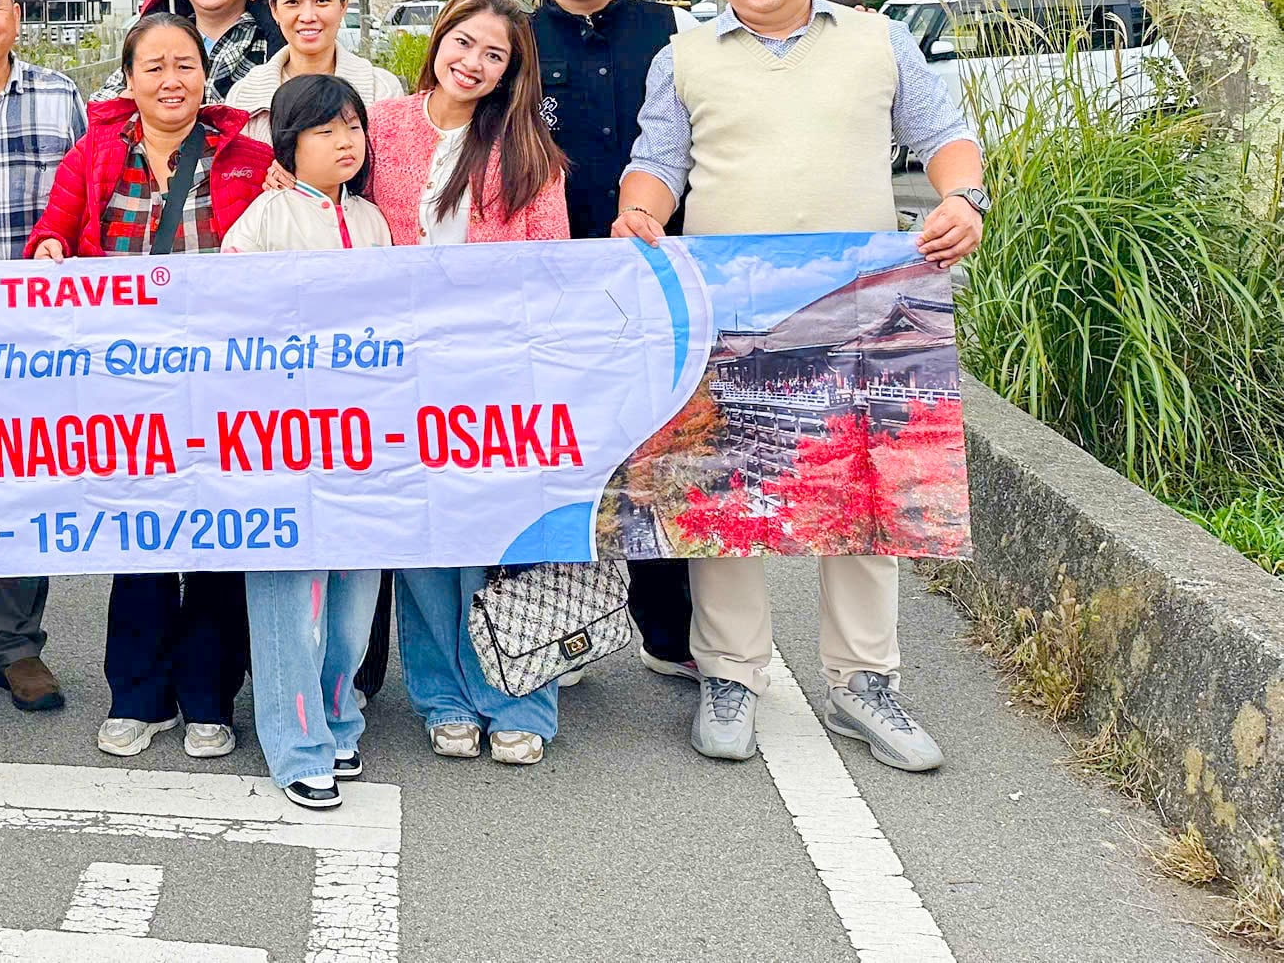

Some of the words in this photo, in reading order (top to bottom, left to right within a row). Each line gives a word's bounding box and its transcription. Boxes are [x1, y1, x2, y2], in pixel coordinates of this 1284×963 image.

[104, 338, 212, 376] Quan
[224, 333, 319, 380] Nhật
[331, 326, 405, 369] Bản
[217, 407, 373, 472] KYOTO
[416, 403, 583, 469] OSAKA
[29, 507, 299, 554] 15/10/2025
